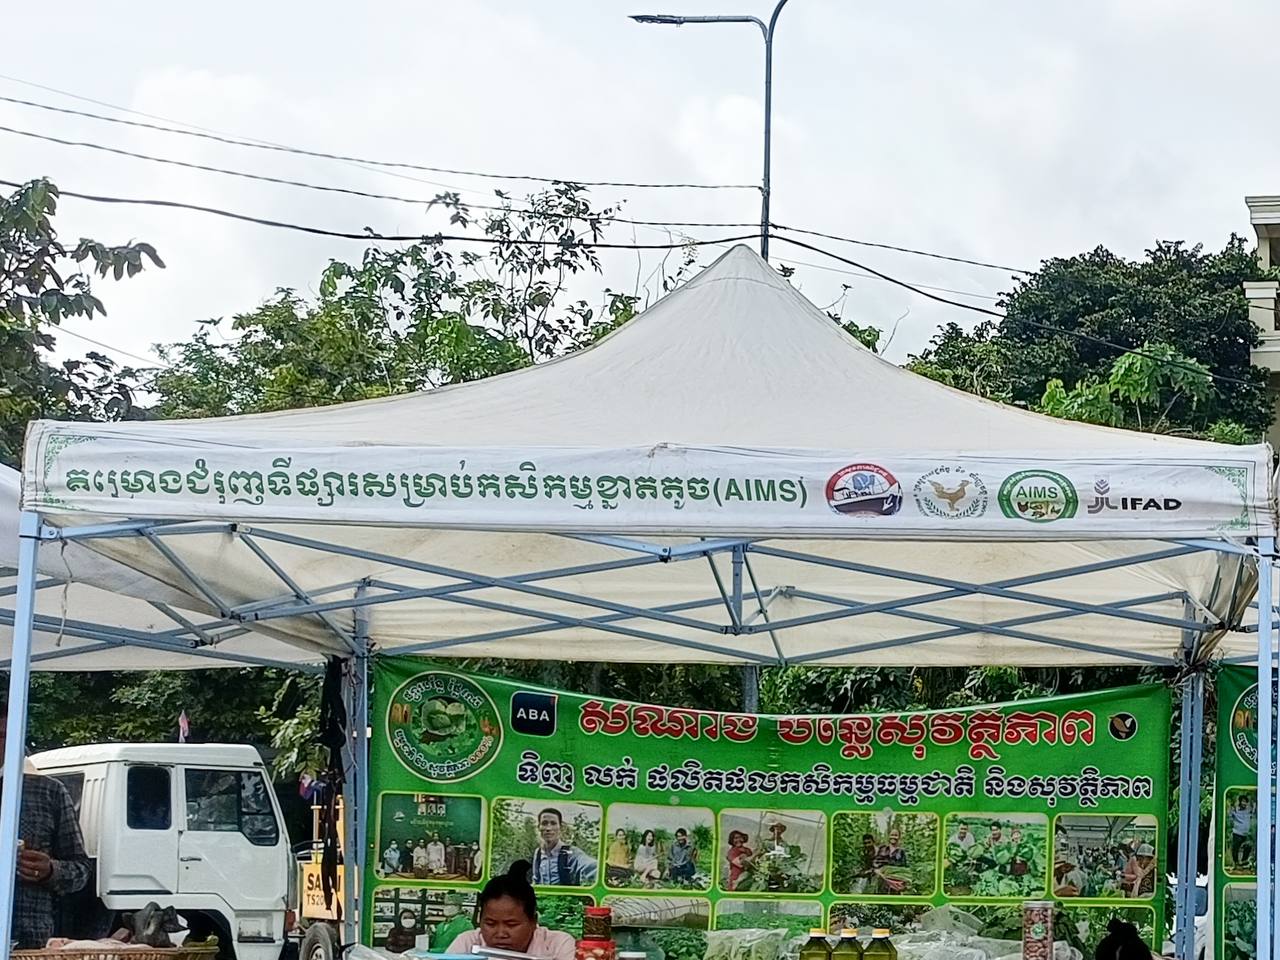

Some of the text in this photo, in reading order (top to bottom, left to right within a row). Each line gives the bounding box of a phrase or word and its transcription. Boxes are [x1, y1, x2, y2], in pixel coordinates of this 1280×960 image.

[1016, 485, 1059, 499] AIMS
[1121, 497, 1183, 511] IFAD
[516, 708, 551, 722] ABA
[515, 751, 576, 794] ទិញ
[584, 758, 638, 790] លក់
